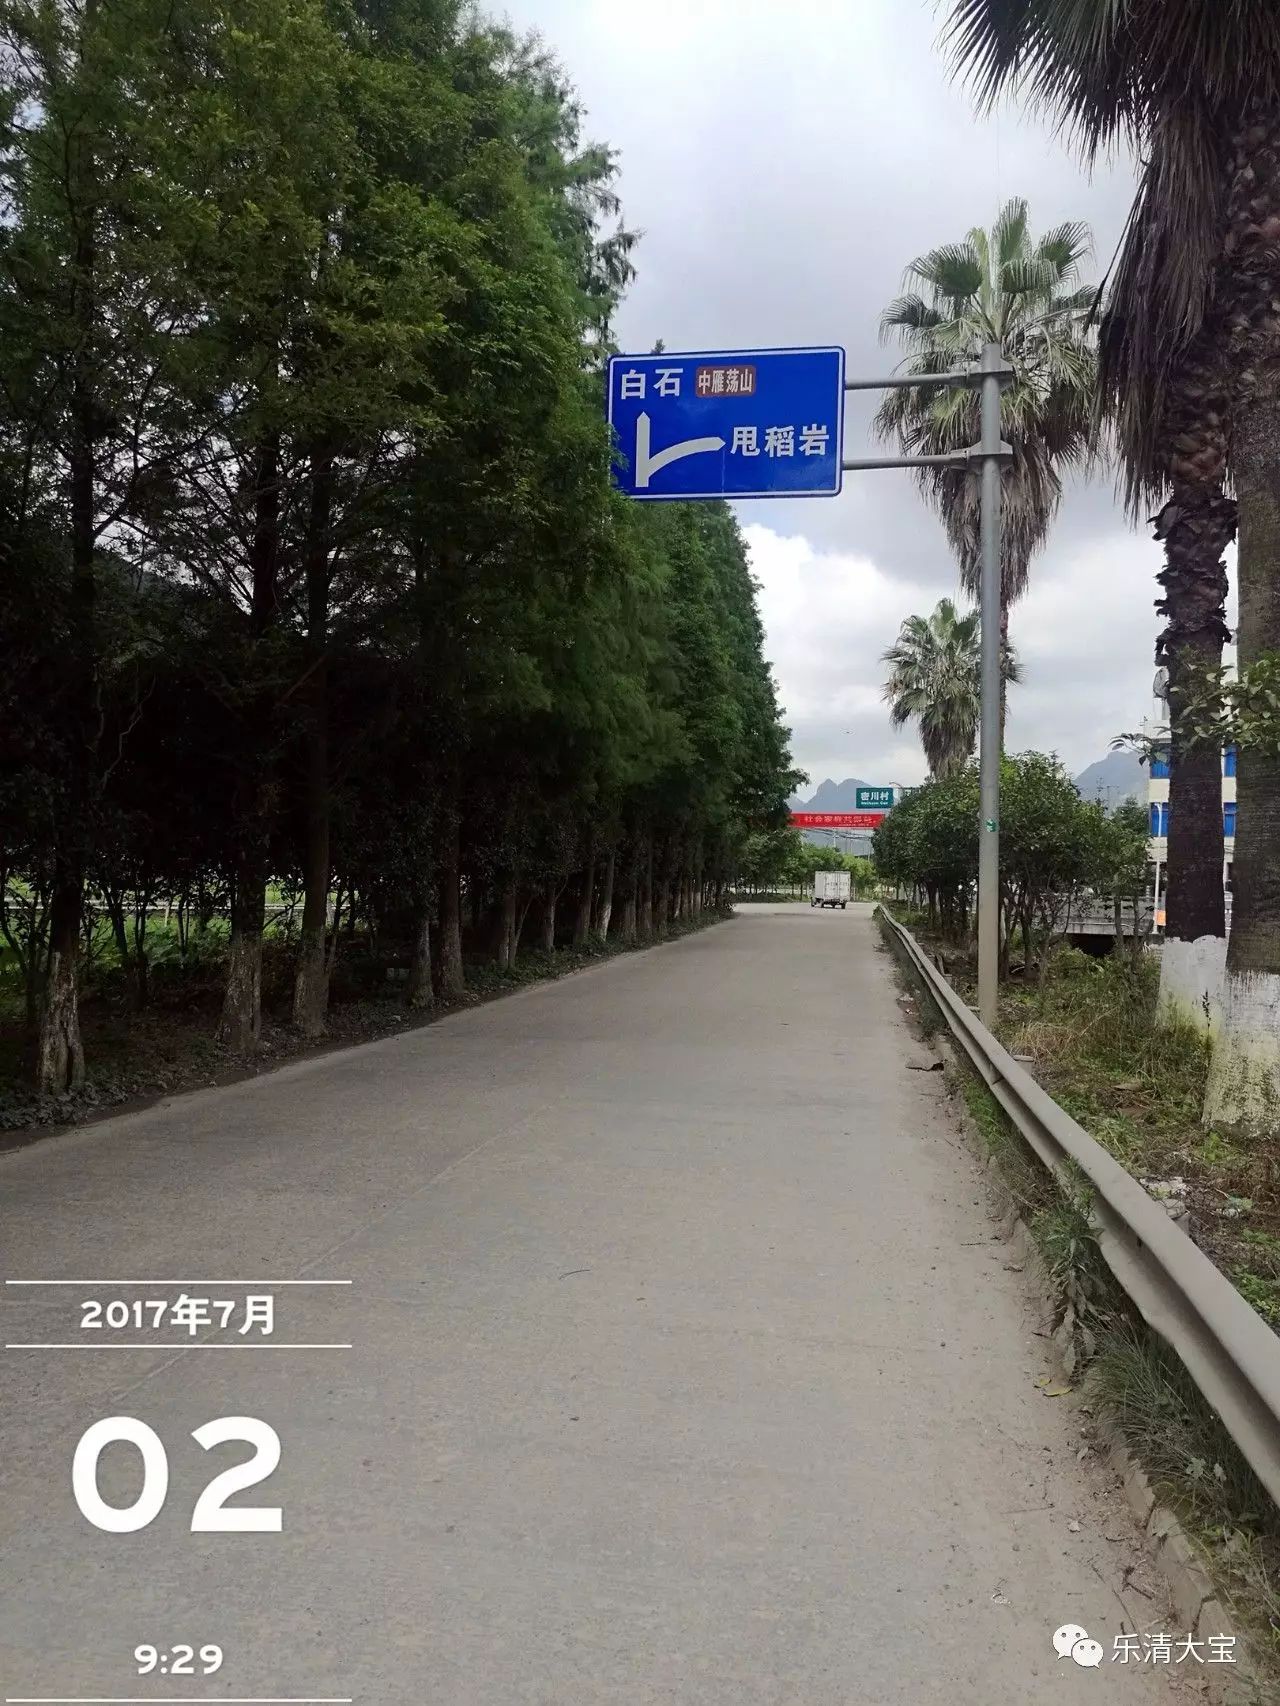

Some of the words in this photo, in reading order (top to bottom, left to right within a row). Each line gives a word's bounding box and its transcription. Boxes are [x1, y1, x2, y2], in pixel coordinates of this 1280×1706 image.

[620, 368, 684, 400] 白石
[698, 368, 753, 395] 中雁荡山
[730, 423, 830, 457] 甩稻岩
